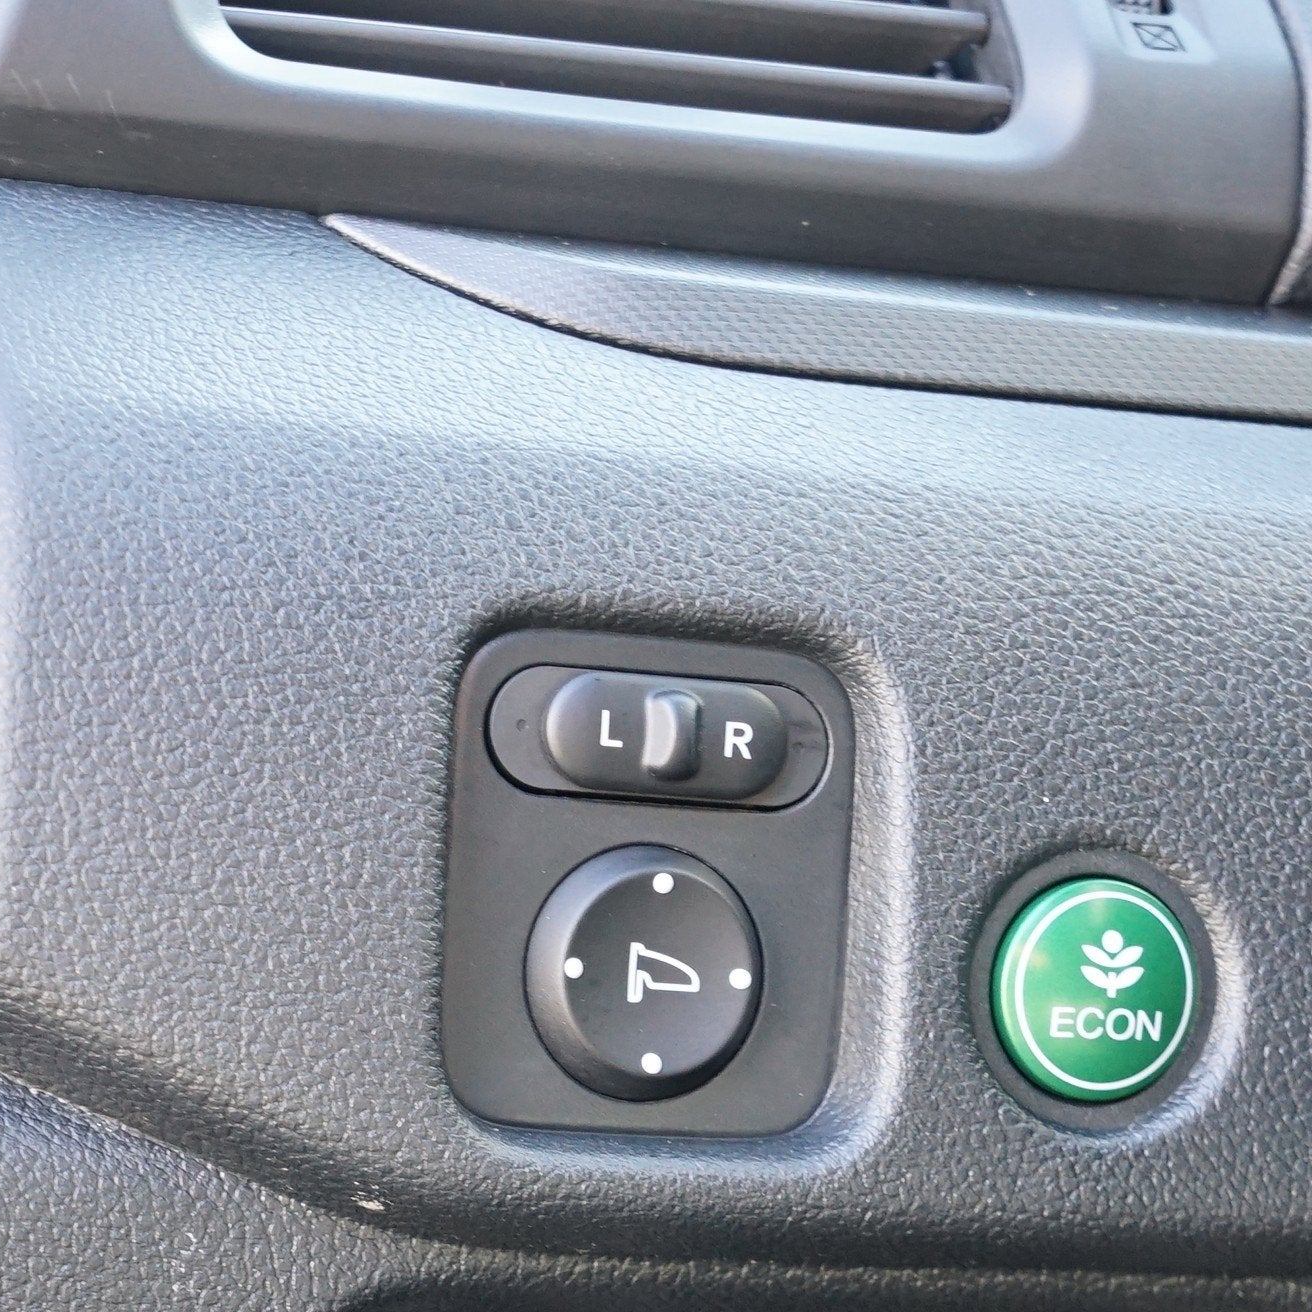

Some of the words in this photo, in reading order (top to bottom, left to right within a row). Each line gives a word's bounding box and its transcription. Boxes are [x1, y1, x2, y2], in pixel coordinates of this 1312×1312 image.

[599, 709, 624, 748] L
[723, 721, 754, 760] R
[1049, 1006, 1163, 1042] ECON
